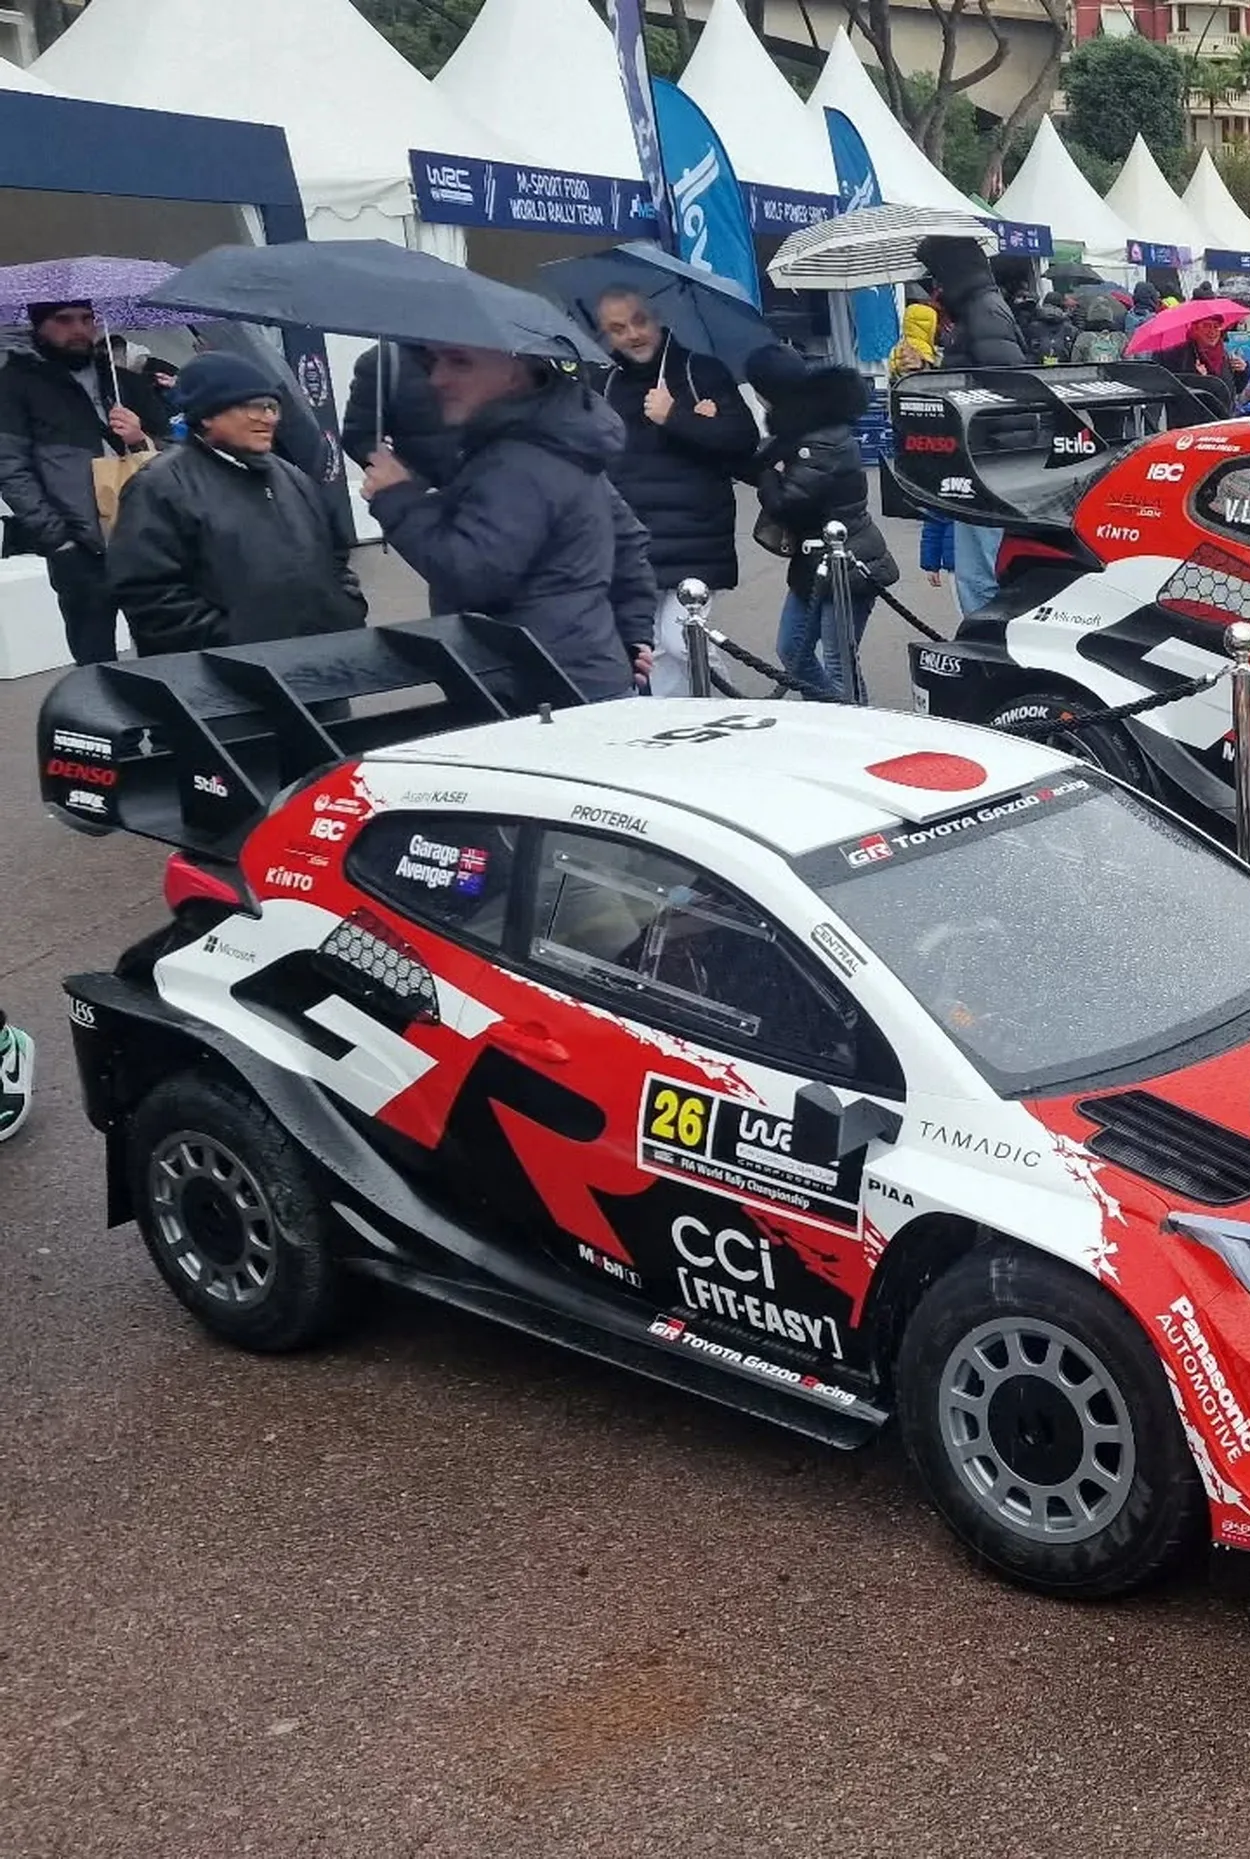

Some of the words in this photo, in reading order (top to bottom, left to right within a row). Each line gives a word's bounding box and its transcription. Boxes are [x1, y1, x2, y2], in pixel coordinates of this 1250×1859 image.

[426, 165, 471, 190] WRC
[516, 172, 563, 198] M-SPORT
[564, 177, 590, 200] FORD
[509, 199, 546, 221] WORLD
[548, 202, 576, 223] RALLY
[576, 205, 604, 226] TEAM
[904, 434, 957, 452] DENSO
[1053, 432, 1096, 454] Stilo
[1052, 610, 1101, 627] Microsoft
[48, 760, 117, 785] DENSO
[194, 775, 228, 798] Stilo
[570, 804, 648, 834] PROTERIAL
[848, 842, 893, 867] GR
[892, 816, 977, 849] TOYOTA
[976, 795, 1040, 822] GAZOO
[409, 834, 460, 866] Garage
[396, 855, 456, 888] Avenger
[812, 923, 860, 974] CENTRAL
[650, 1089, 706, 1147] 26
[919, 1120, 1041, 1168] TAMADIC
[681, 1158, 696, 1171] FIA
[696, 1163, 723, 1181] World
[725, 1171, 746, 1190] Rally
[747, 1180, 811, 1209] Championship
[867, 1178, 916, 1208] PIAA
[579, 1244, 624, 1280] Mobil
[648, 1318, 685, 1342] GR
[682, 1332, 742, 1363] TOYOTA
[743, 1355, 800, 1384] GAZOO
[800, 1375, 857, 1405] Racing
[1155, 1313, 1243, 1466] AUTOMOTIVE
